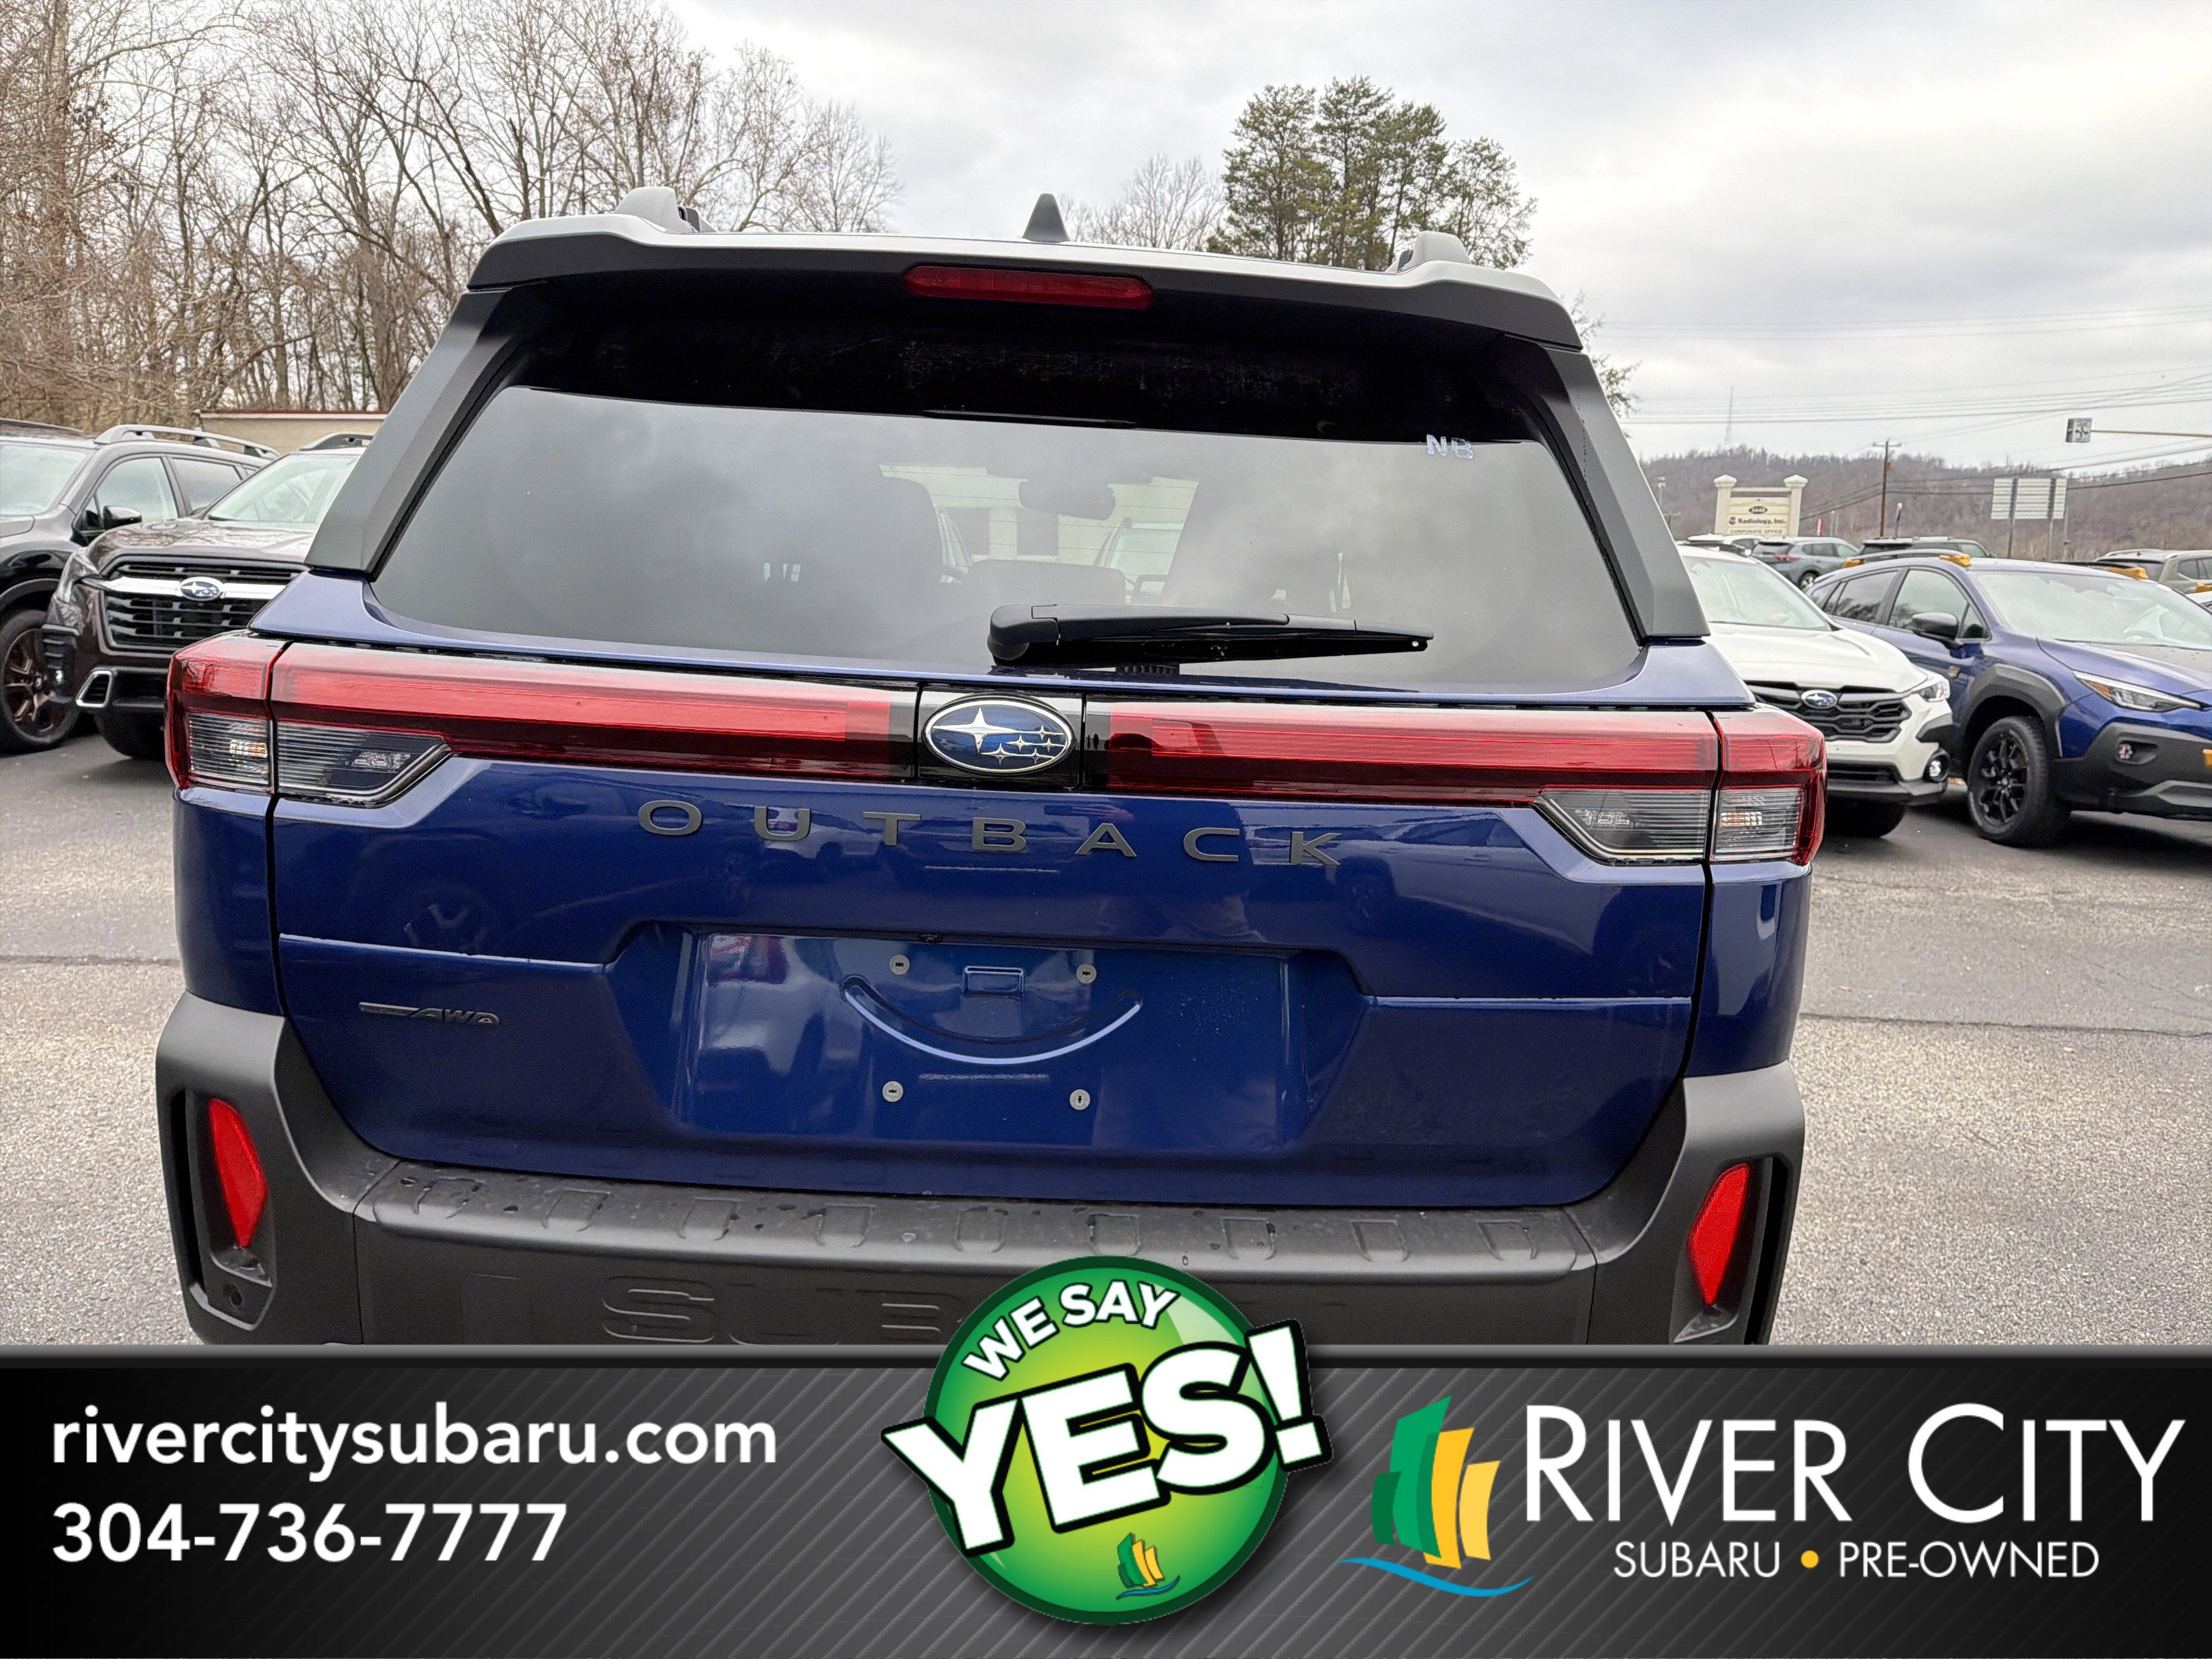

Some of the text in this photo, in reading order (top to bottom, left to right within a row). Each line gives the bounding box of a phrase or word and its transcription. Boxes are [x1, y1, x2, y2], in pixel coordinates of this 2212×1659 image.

[1426, 433, 1475, 460] NB
[637, 799, 1342, 866] OUTBACK
[411, 1007, 500, 1025] AWD
